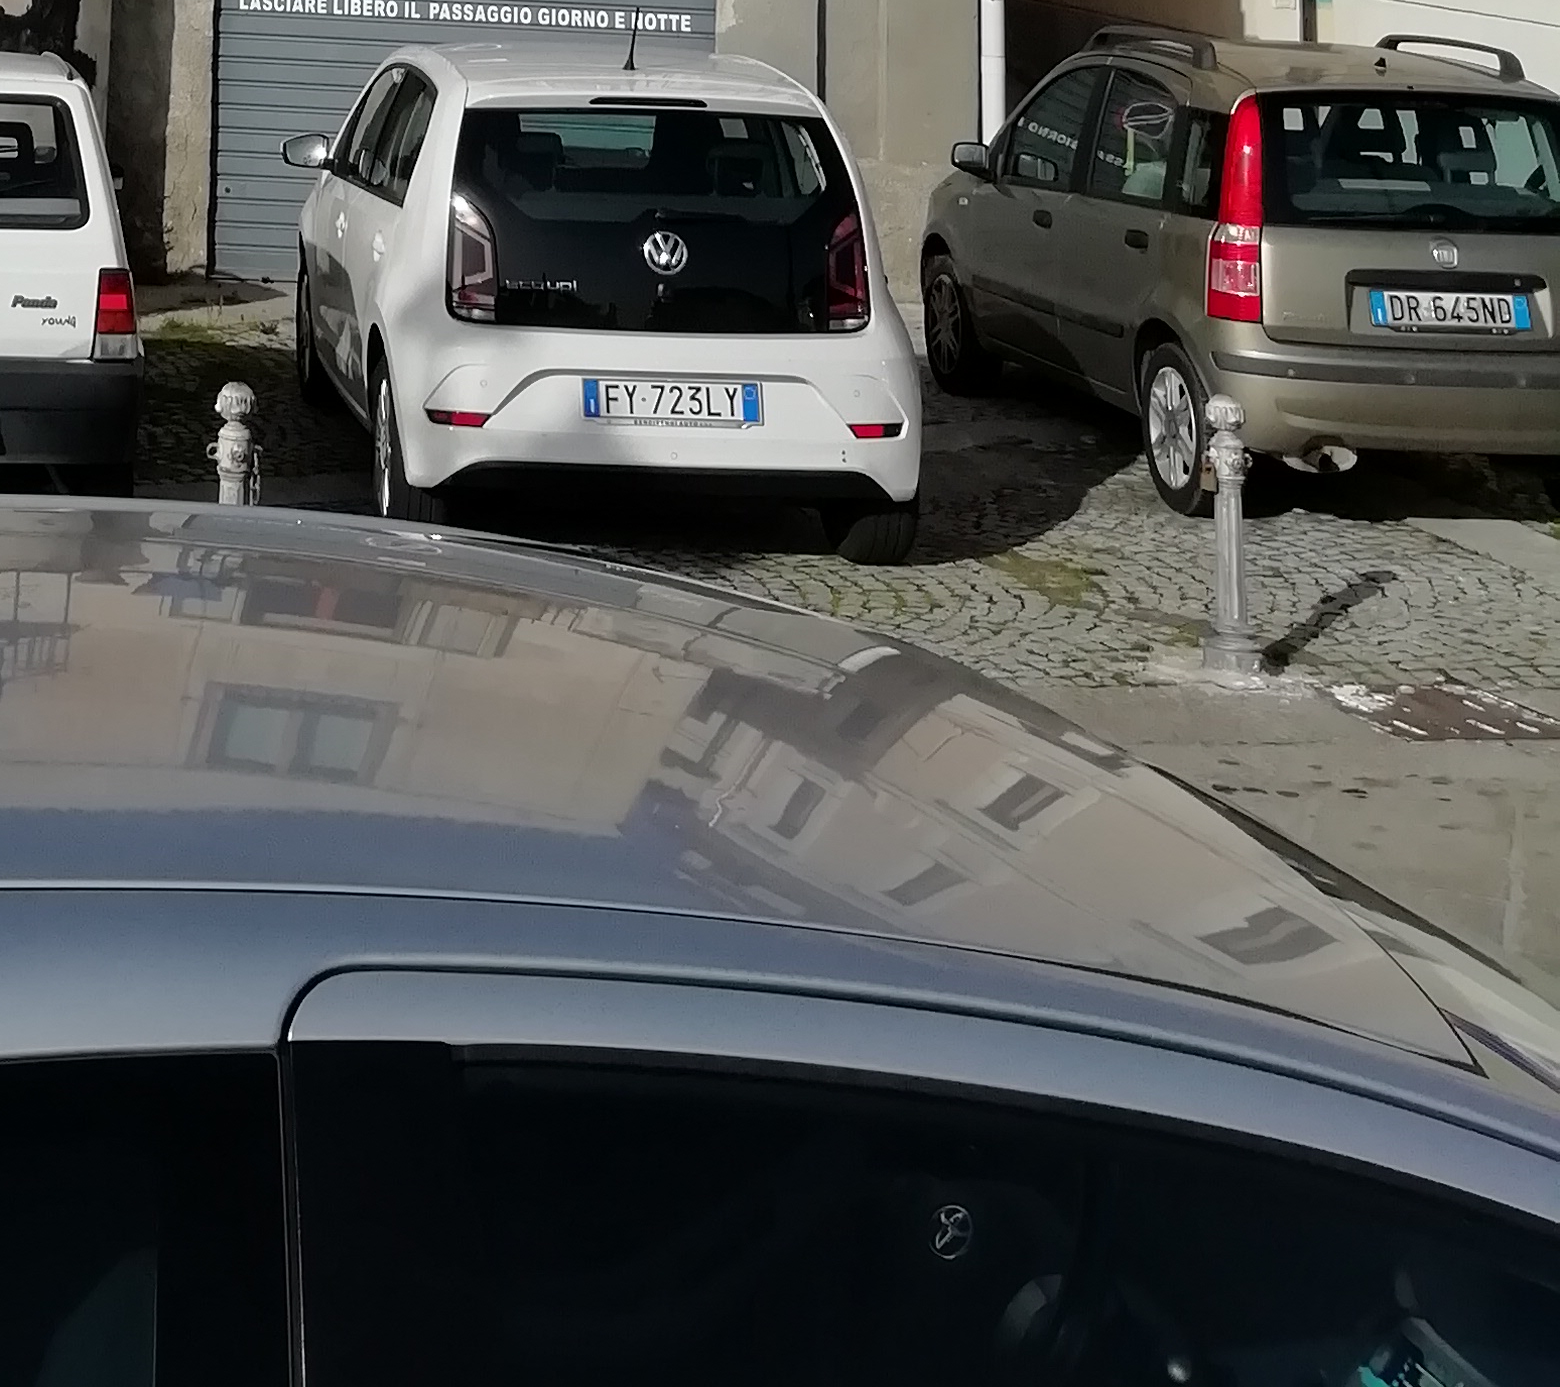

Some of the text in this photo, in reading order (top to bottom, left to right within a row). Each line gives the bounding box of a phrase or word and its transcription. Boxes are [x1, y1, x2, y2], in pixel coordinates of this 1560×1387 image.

[404, 1, 421, 19] IL
[429, 2, 533, 25] PASSAGGIO
[537, 7, 610, 29] GIORNO
[614, 11, 626, 29] E
[631, 11, 692, 32] NOTTE
[11, 294, 58, 310] Panda
[1389, 294, 1422, 322] DR
[1432, 296, 1512, 325] 645ND
[604, 384, 638, 415] FY
[651, 384, 738, 418] 723LY
